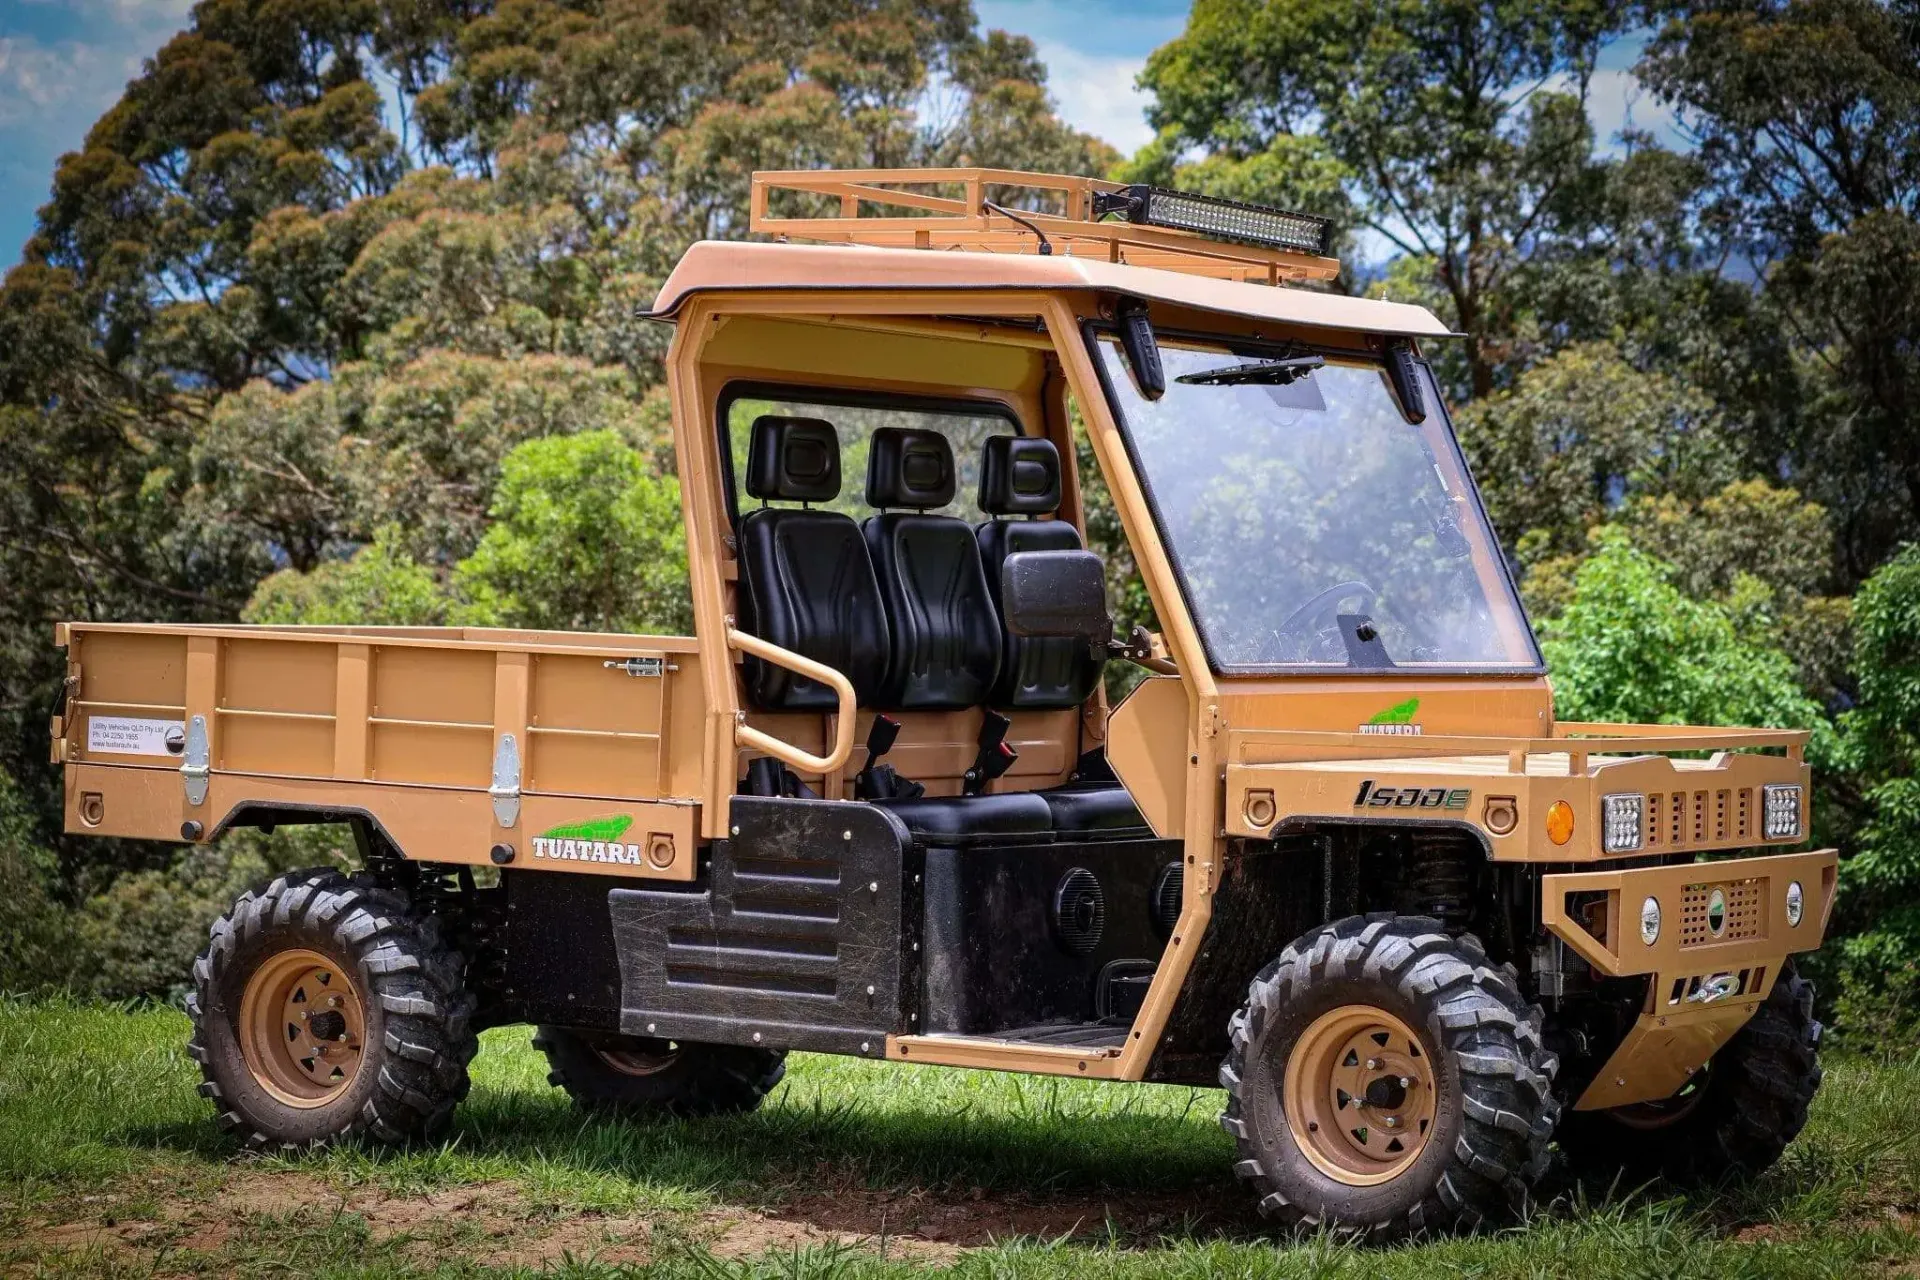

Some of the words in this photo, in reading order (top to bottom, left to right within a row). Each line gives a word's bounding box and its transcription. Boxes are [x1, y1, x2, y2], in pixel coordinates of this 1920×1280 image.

[92, 723, 107, 731] Utility
[108, 723, 130, 731] Vehicles
[144, 725, 154, 734] Pty
[532, 837, 642, 865] TUATARA
